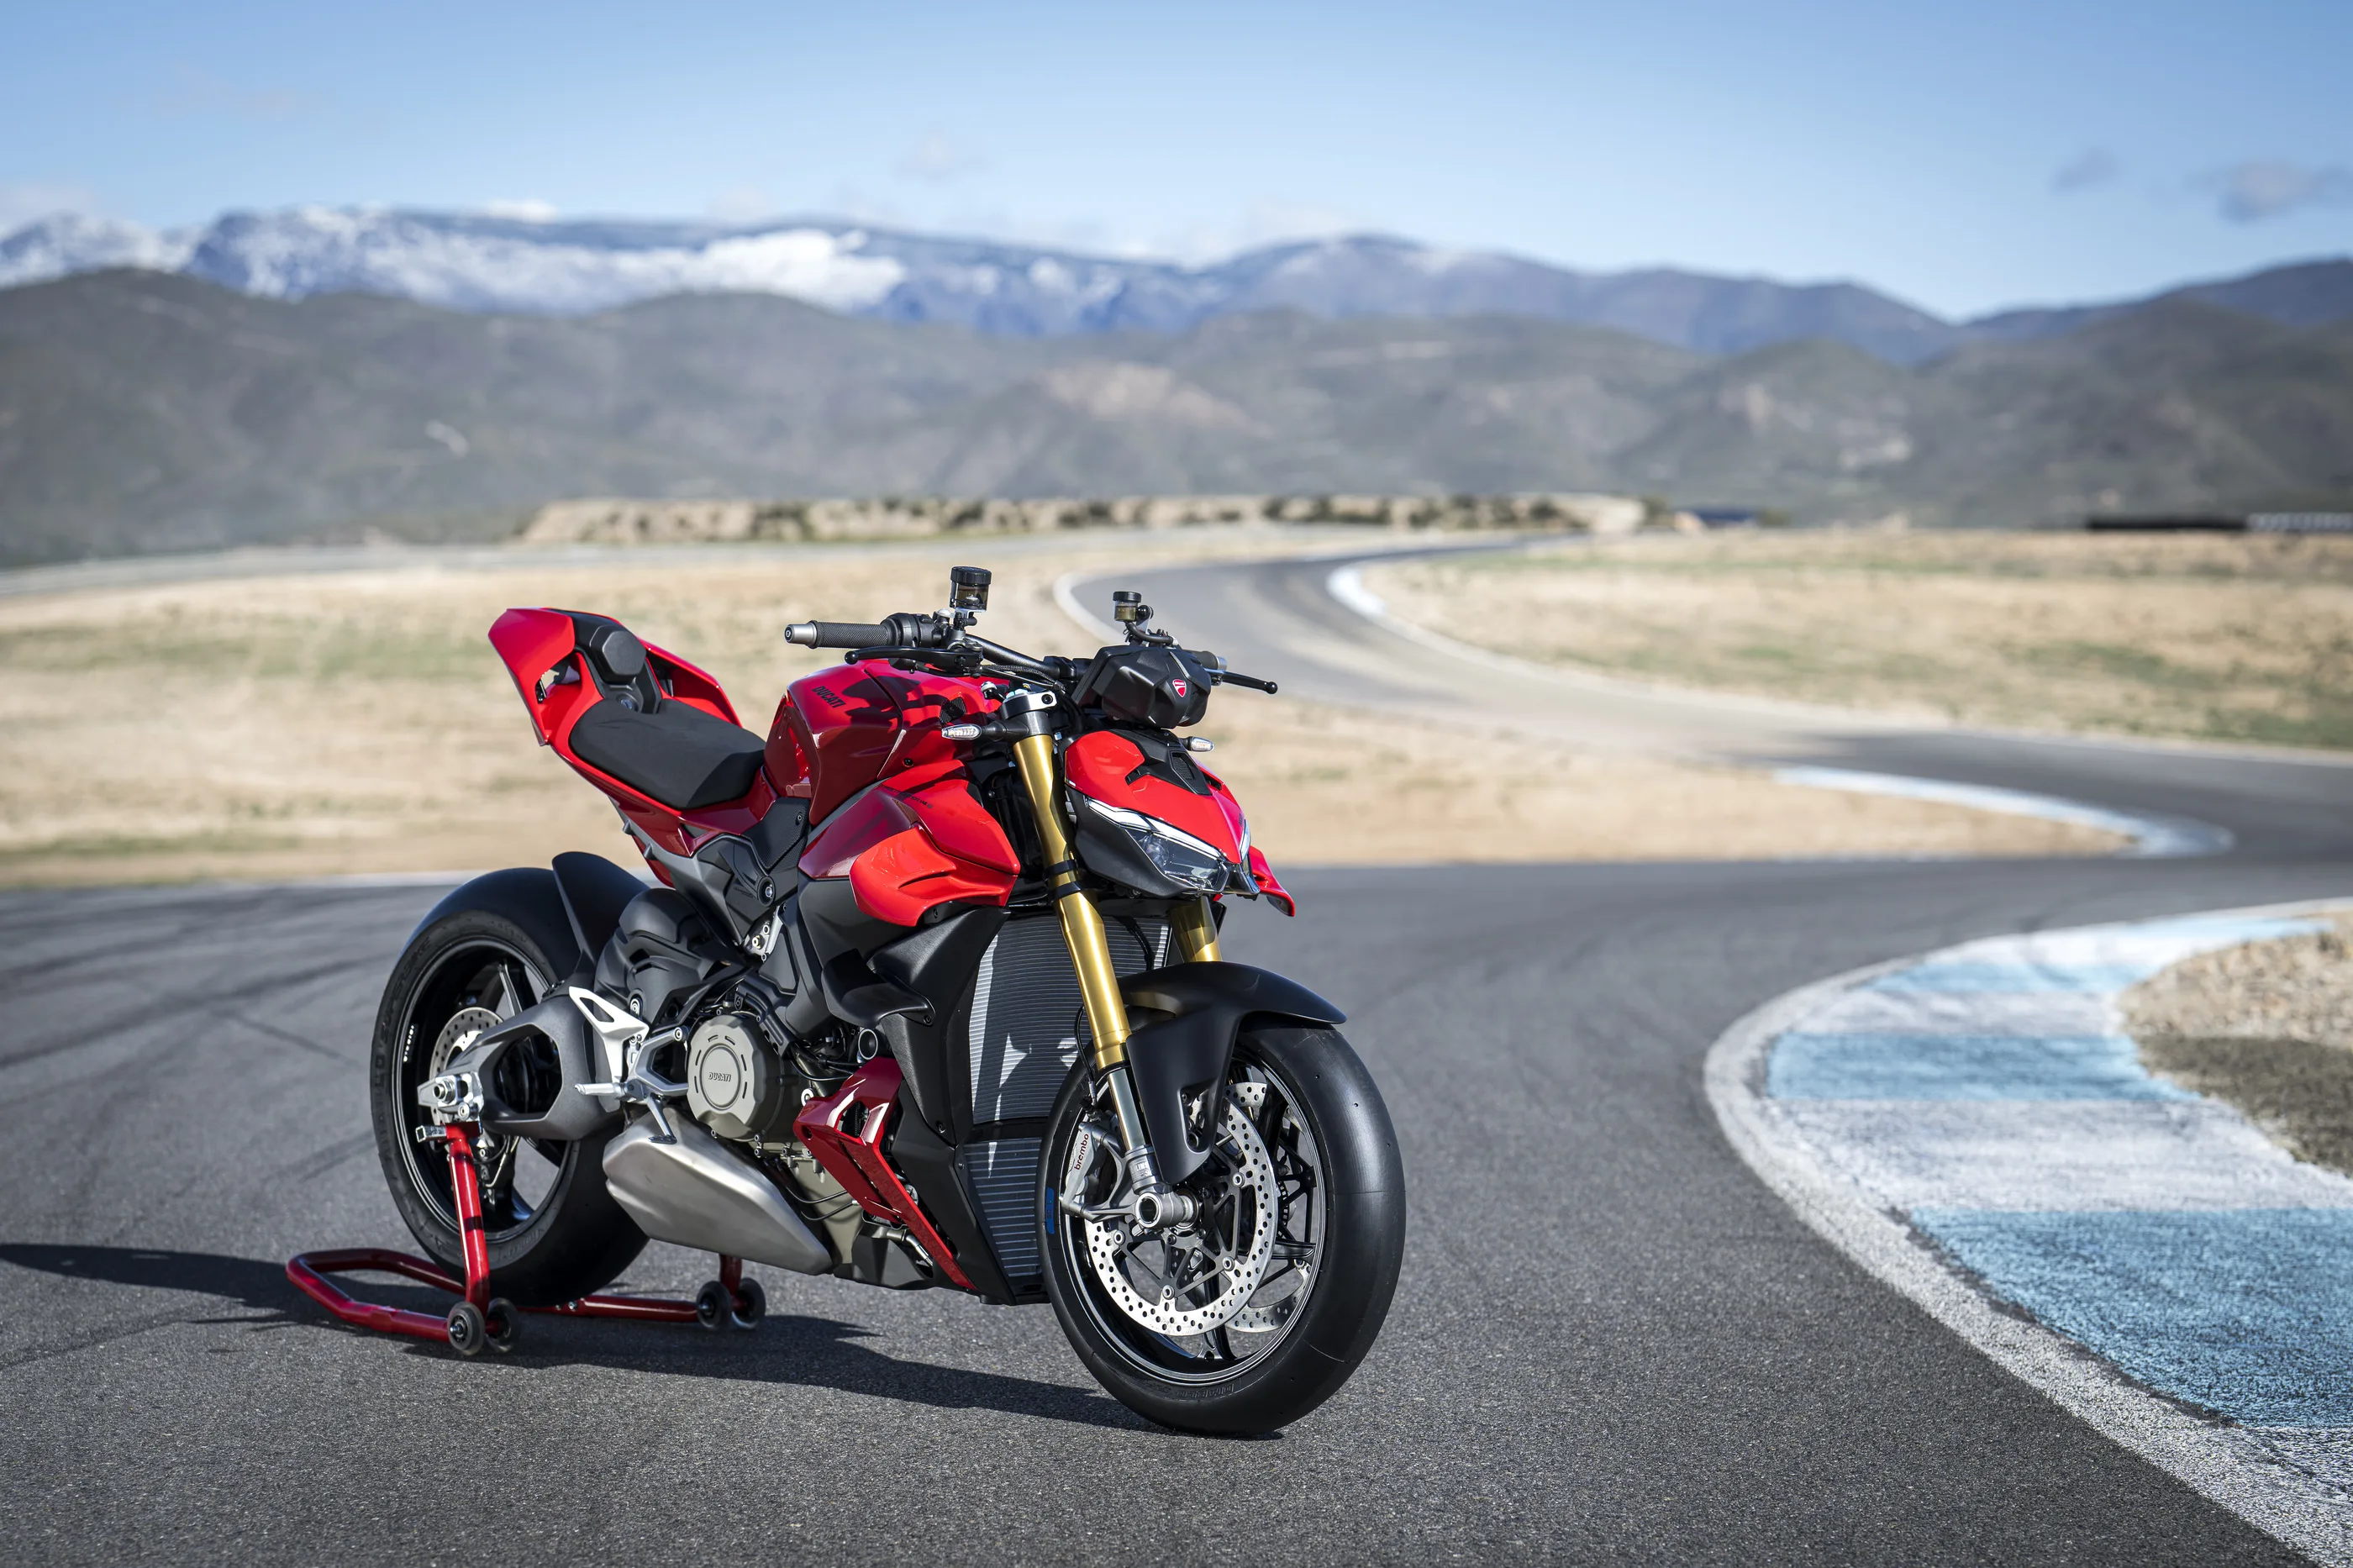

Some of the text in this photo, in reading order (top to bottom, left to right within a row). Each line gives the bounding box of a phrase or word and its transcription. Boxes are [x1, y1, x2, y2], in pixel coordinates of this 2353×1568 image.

[811, 685, 846, 708] DUCATI
[708, 1071, 732, 1082] DUCATI
[1074, 1134, 1089, 1171] brembo
